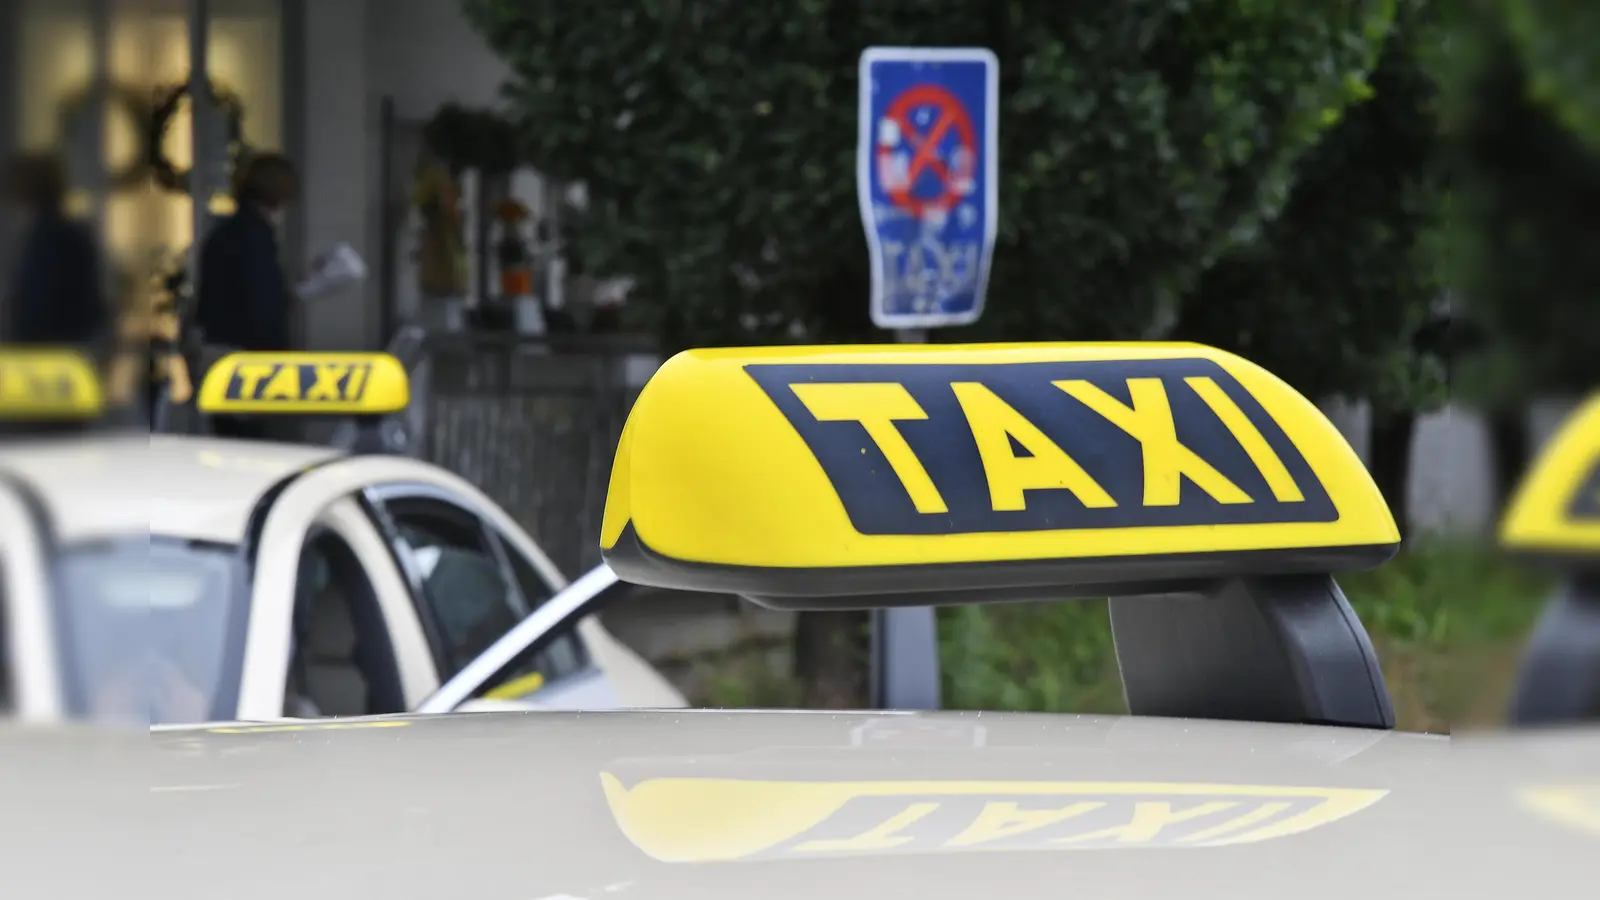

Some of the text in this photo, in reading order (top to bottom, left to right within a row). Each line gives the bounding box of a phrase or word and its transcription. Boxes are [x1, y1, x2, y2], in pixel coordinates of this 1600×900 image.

[881, 241, 978, 289] TAXI
[236, 363, 372, 400] TAXI
[789, 376, 1306, 514] TAXI
